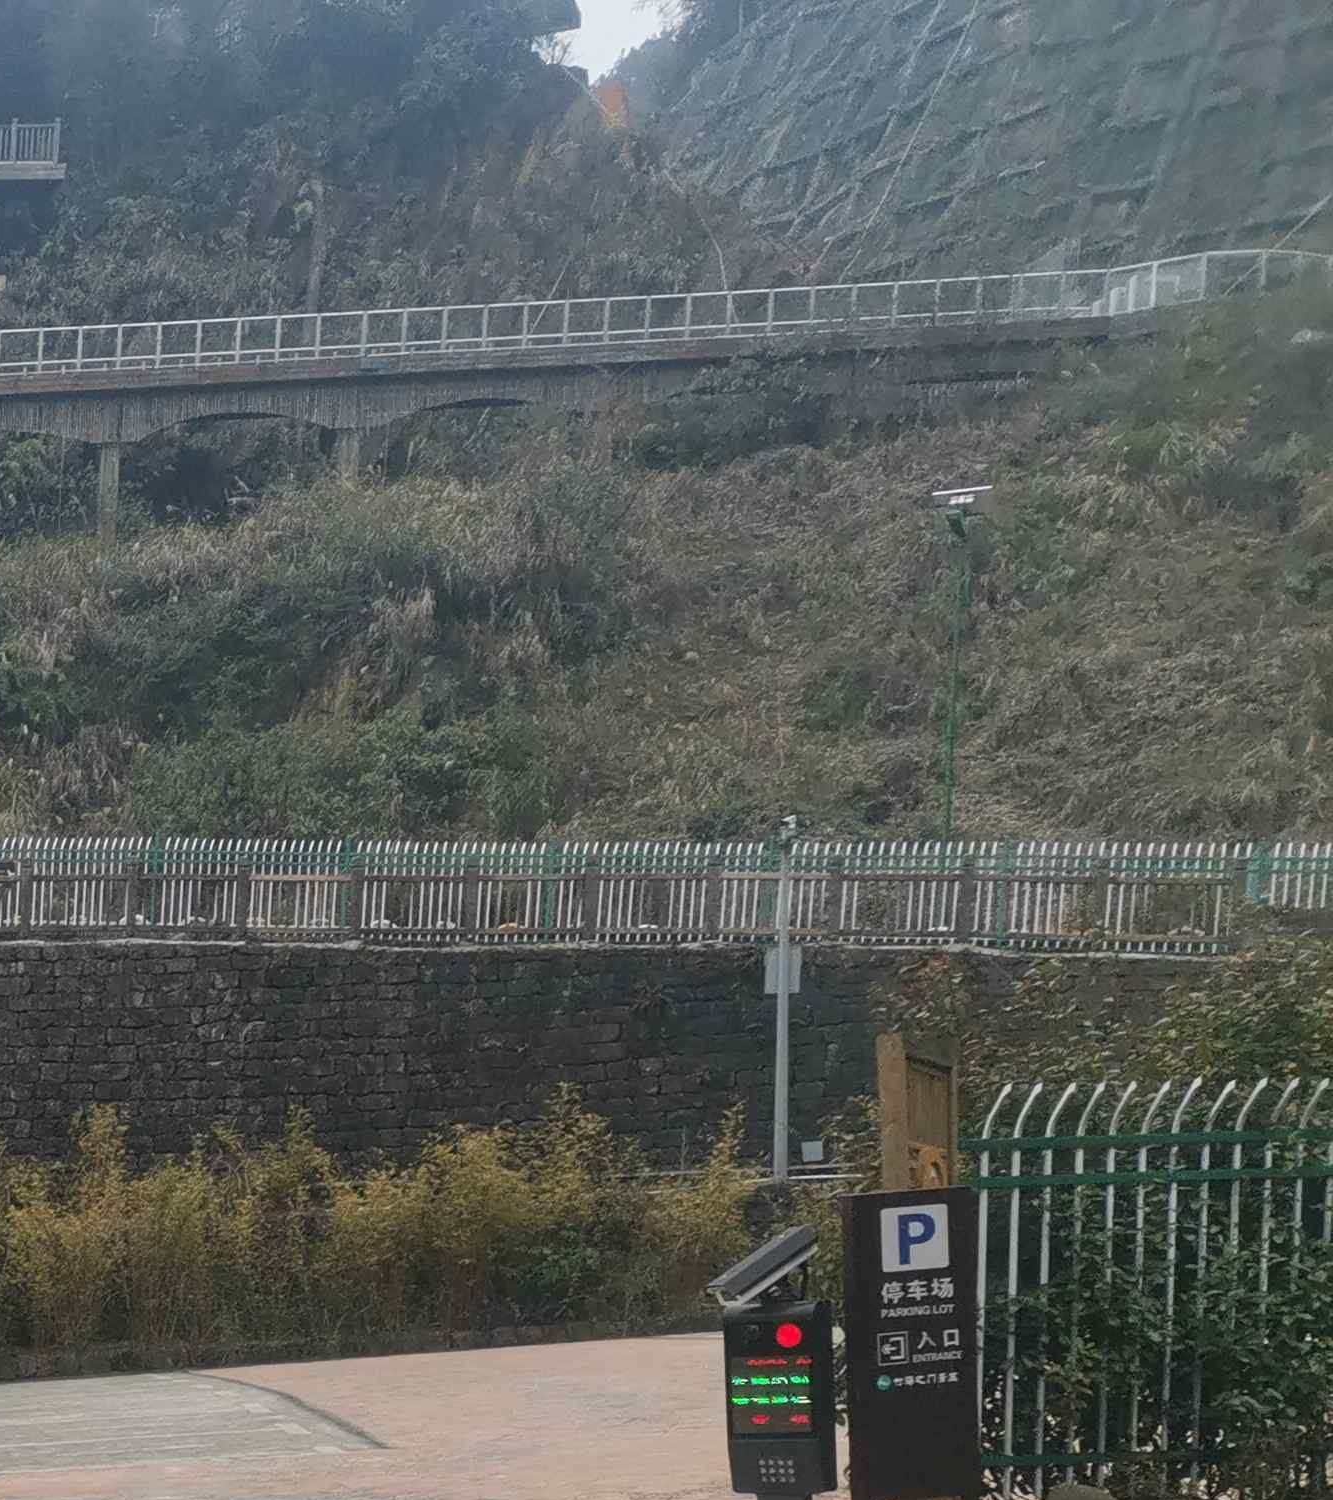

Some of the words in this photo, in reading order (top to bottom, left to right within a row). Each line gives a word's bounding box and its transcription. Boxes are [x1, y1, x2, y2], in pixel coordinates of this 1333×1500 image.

[897, 1213, 936, 1266] P
[881, 1277, 954, 1304] 停车场
[880, 1305, 931, 1319] PARKING
[933, 1304, 955, 1315] LOT
[917, 1328, 960, 1349] 入口
[912, 1350, 963, 1363] ENTRANCE
